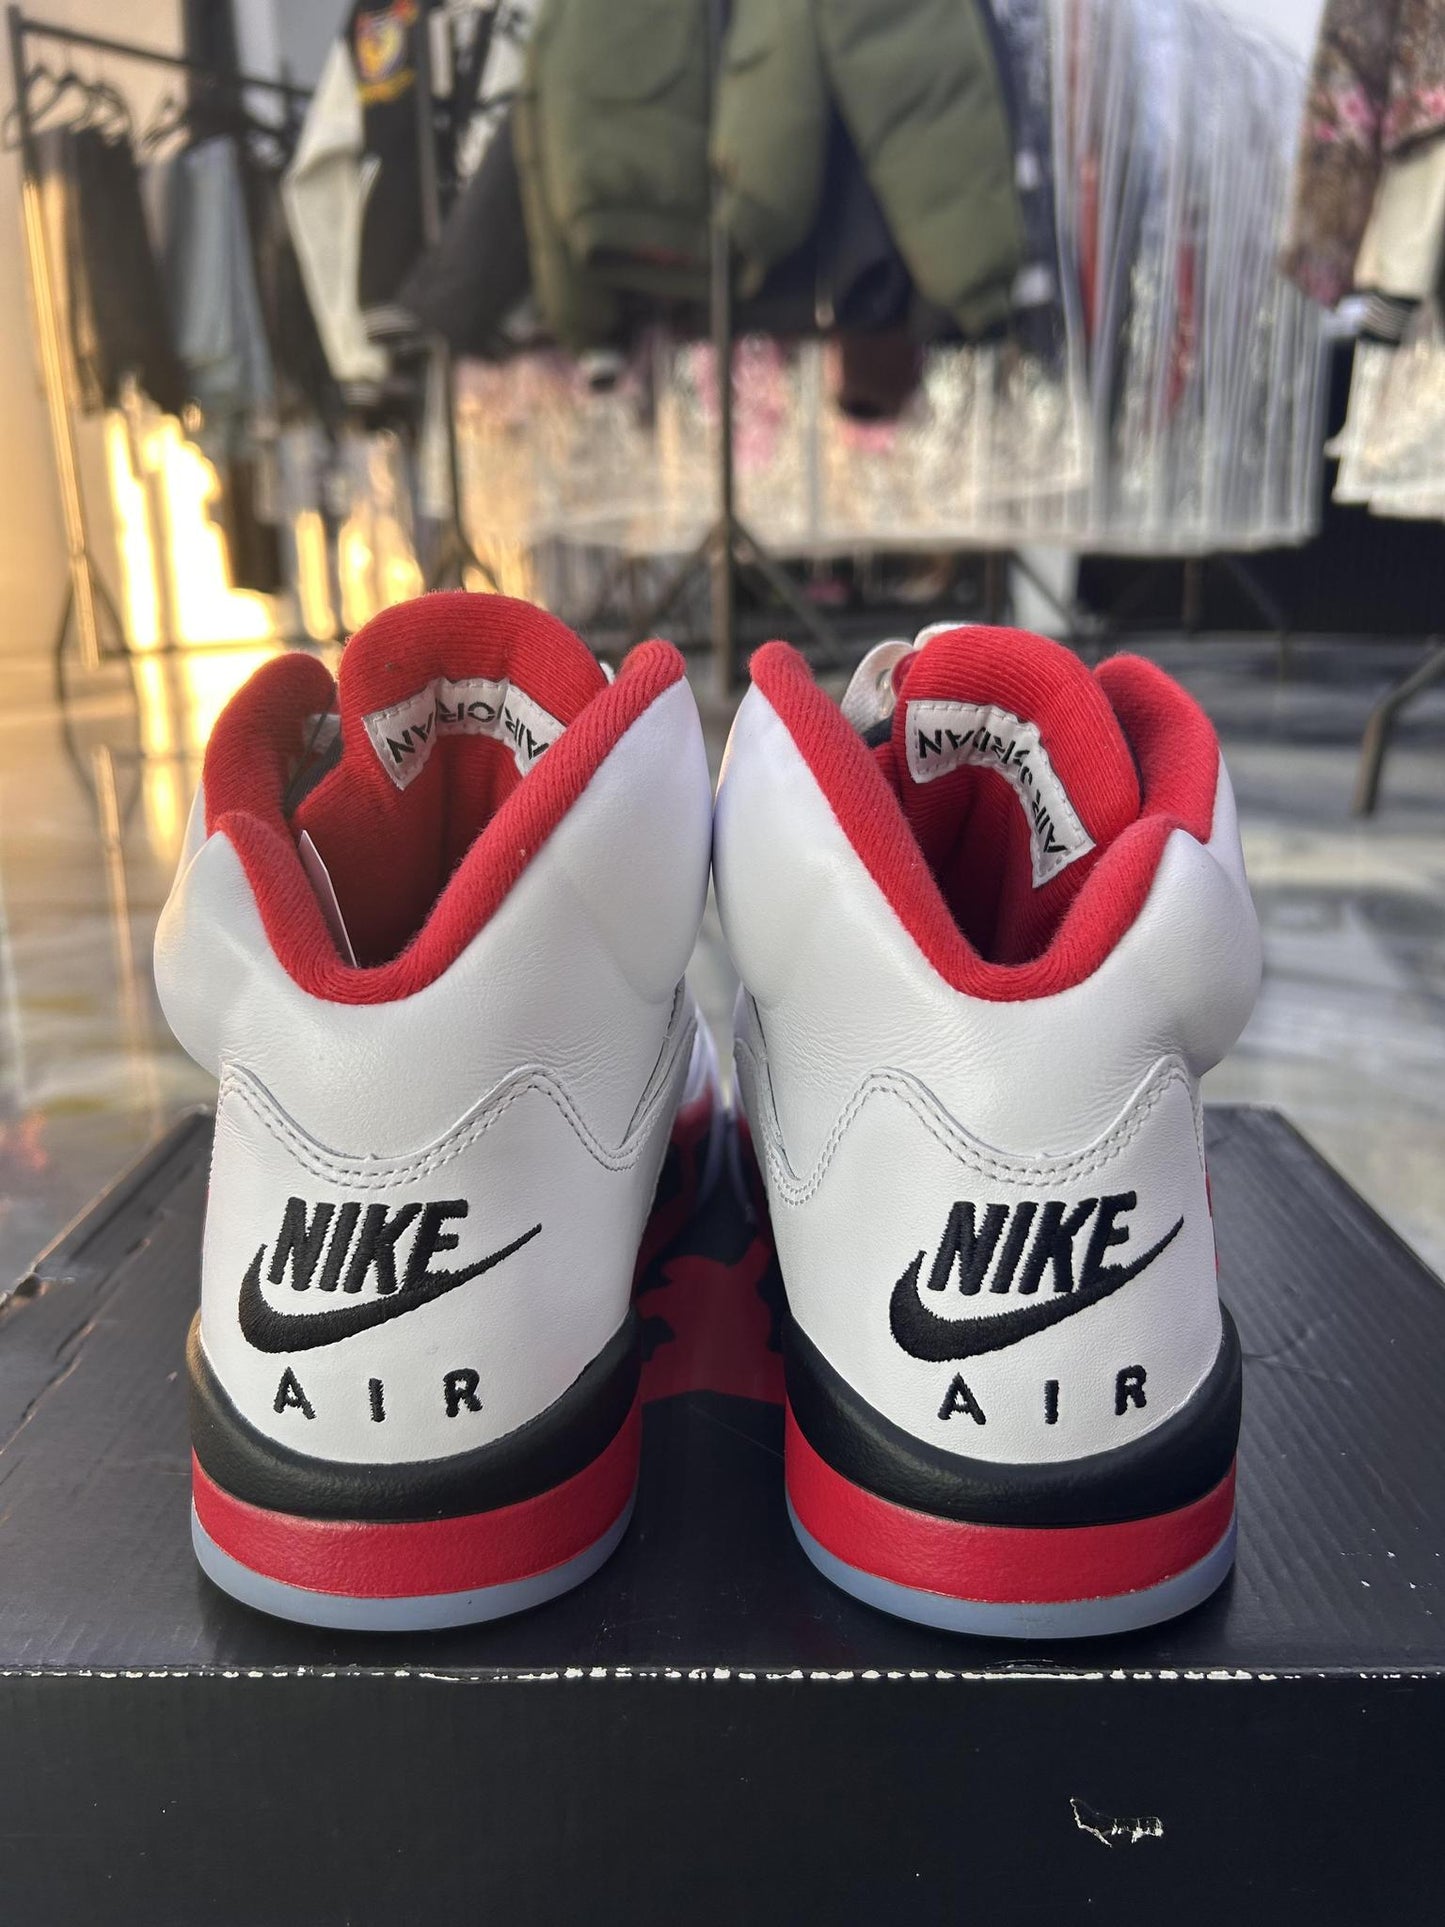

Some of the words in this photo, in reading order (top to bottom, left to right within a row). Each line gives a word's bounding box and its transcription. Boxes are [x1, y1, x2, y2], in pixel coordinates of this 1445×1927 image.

[386, 698, 504, 764] ORAN
[505, 706, 550, 761] AIR
[1032, 789, 1068, 854] AIR
[267, 1196, 469, 1295] NIKE
[927, 1190, 1137, 1296] NIKE
[273, 1366, 483, 1423] AIR
[937, 1364, 1147, 1425] AIR
